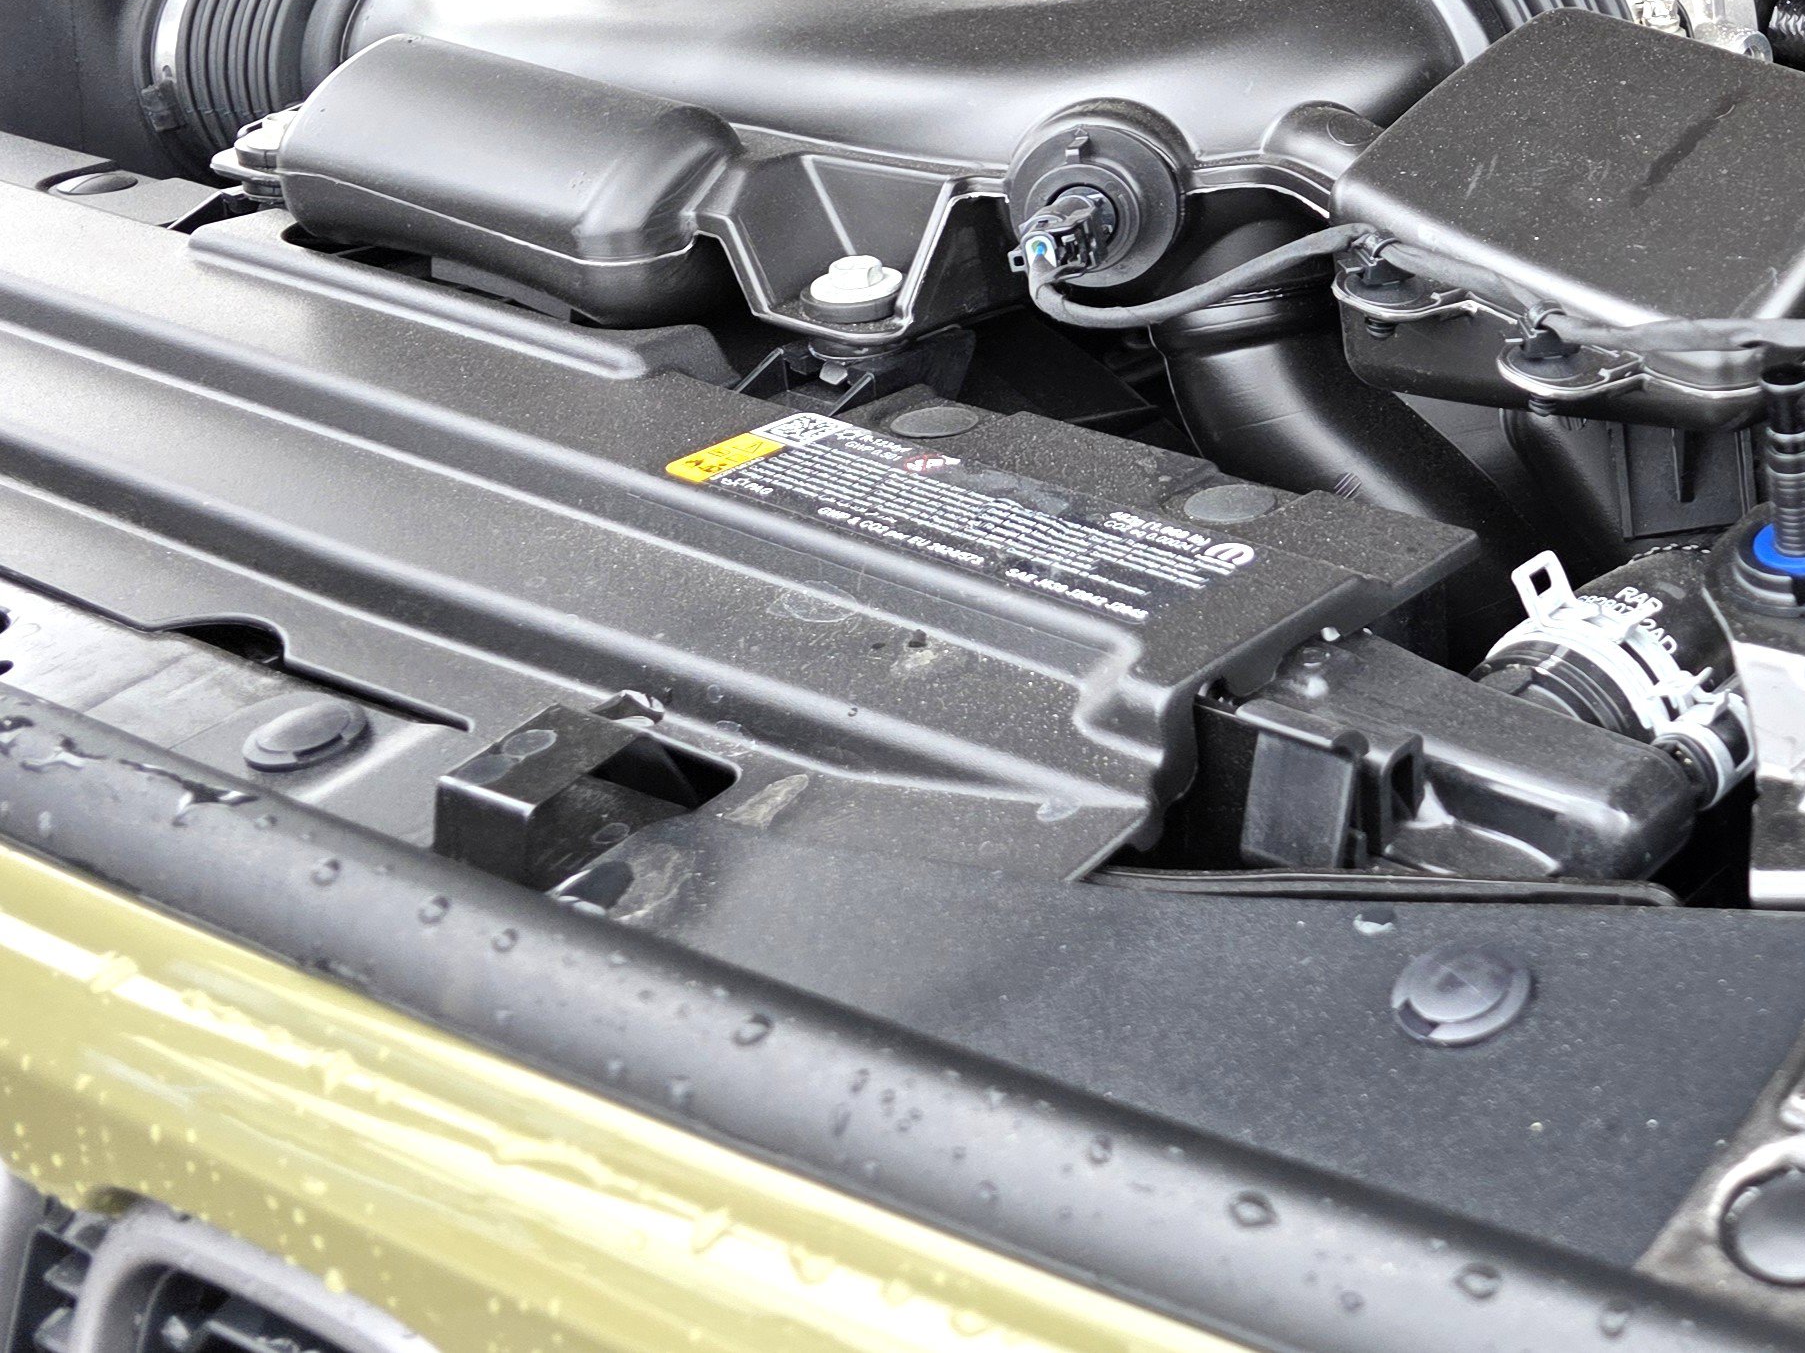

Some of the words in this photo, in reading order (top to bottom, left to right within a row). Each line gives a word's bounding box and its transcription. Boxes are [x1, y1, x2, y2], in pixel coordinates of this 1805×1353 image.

[844, 441, 876, 452] GWP
[817, 506, 852, 520] GWP
[906, 536, 932, 547] EU
[1005, 568, 1038, 582] SAE
[1614, 586, 1664, 615] RAD
